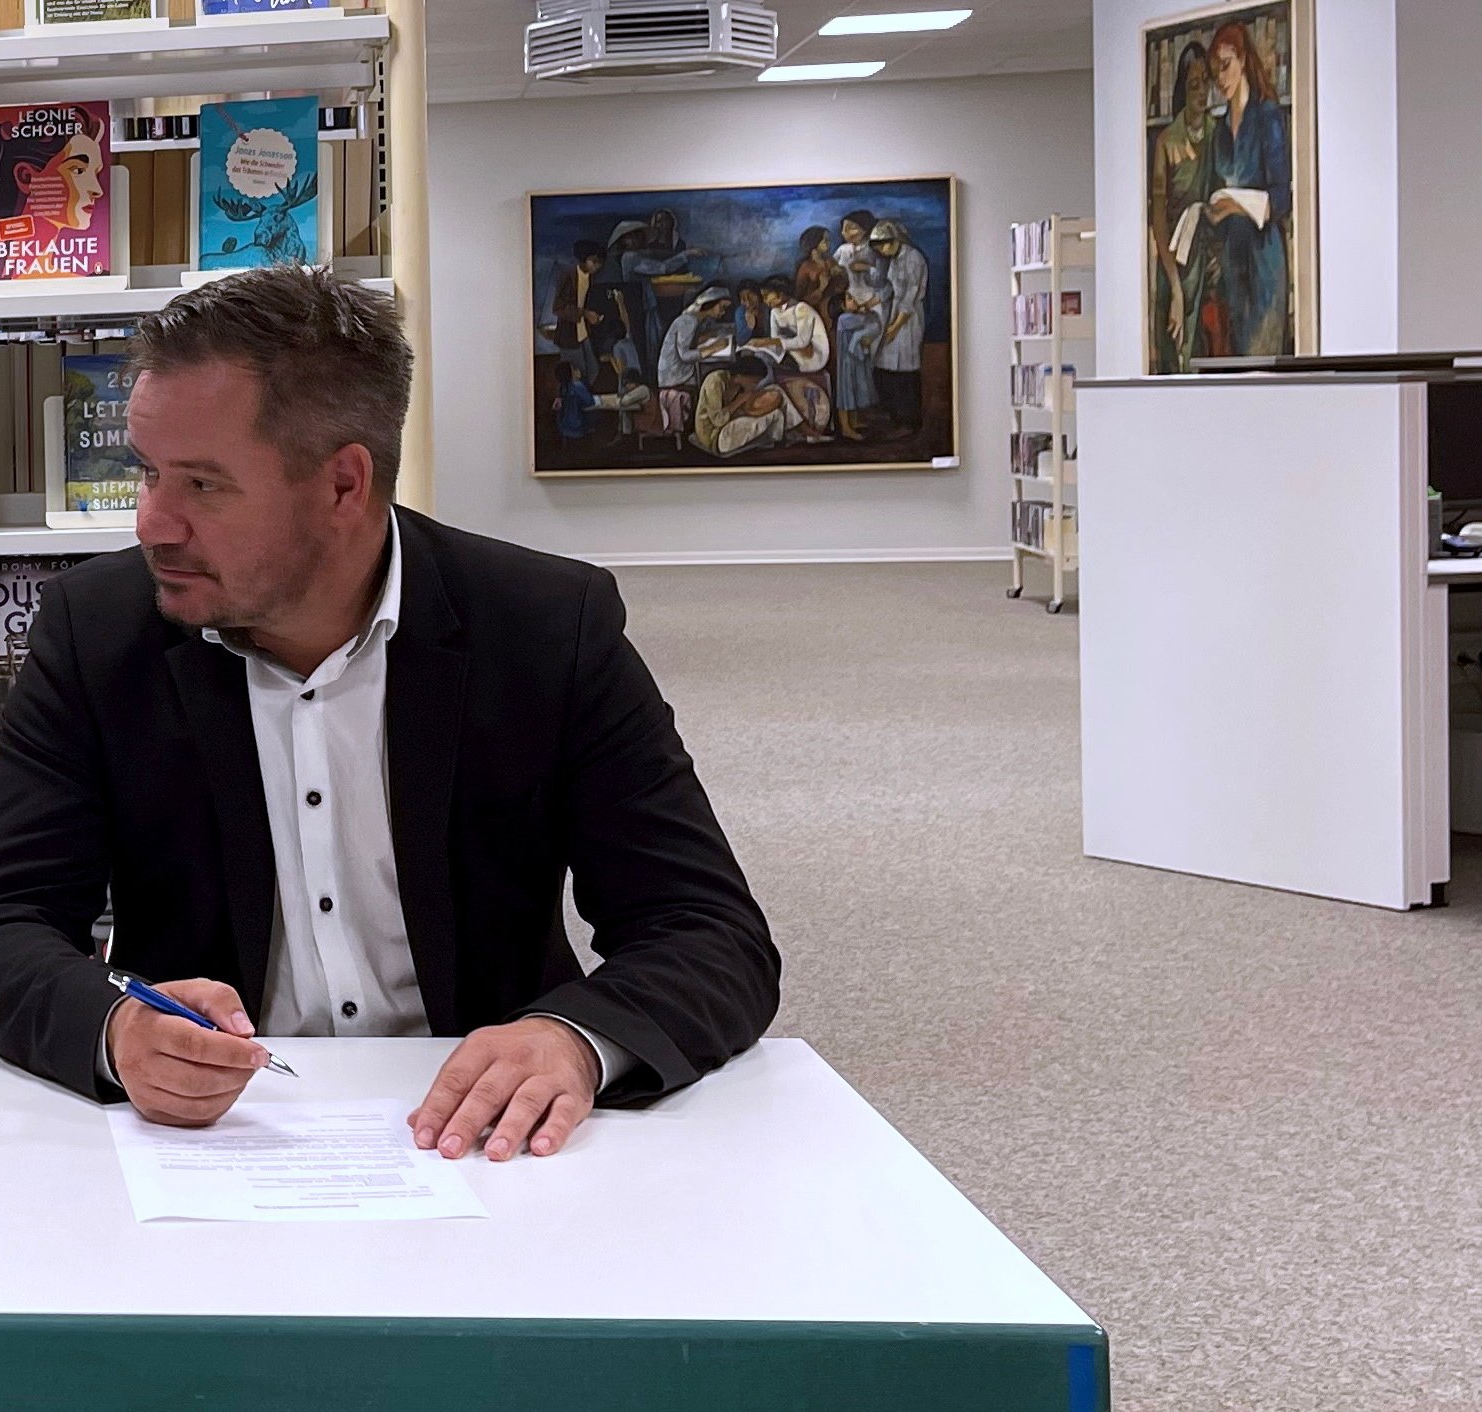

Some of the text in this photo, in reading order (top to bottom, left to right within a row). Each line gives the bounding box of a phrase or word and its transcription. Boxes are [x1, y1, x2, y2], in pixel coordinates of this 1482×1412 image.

[18, 107, 77, 124] LEONIE
[11, 121, 84, 139] SCHÖLER
[4, 255, 89, 276] FRAUEN
[1, 562, 42, 572] ROMY
